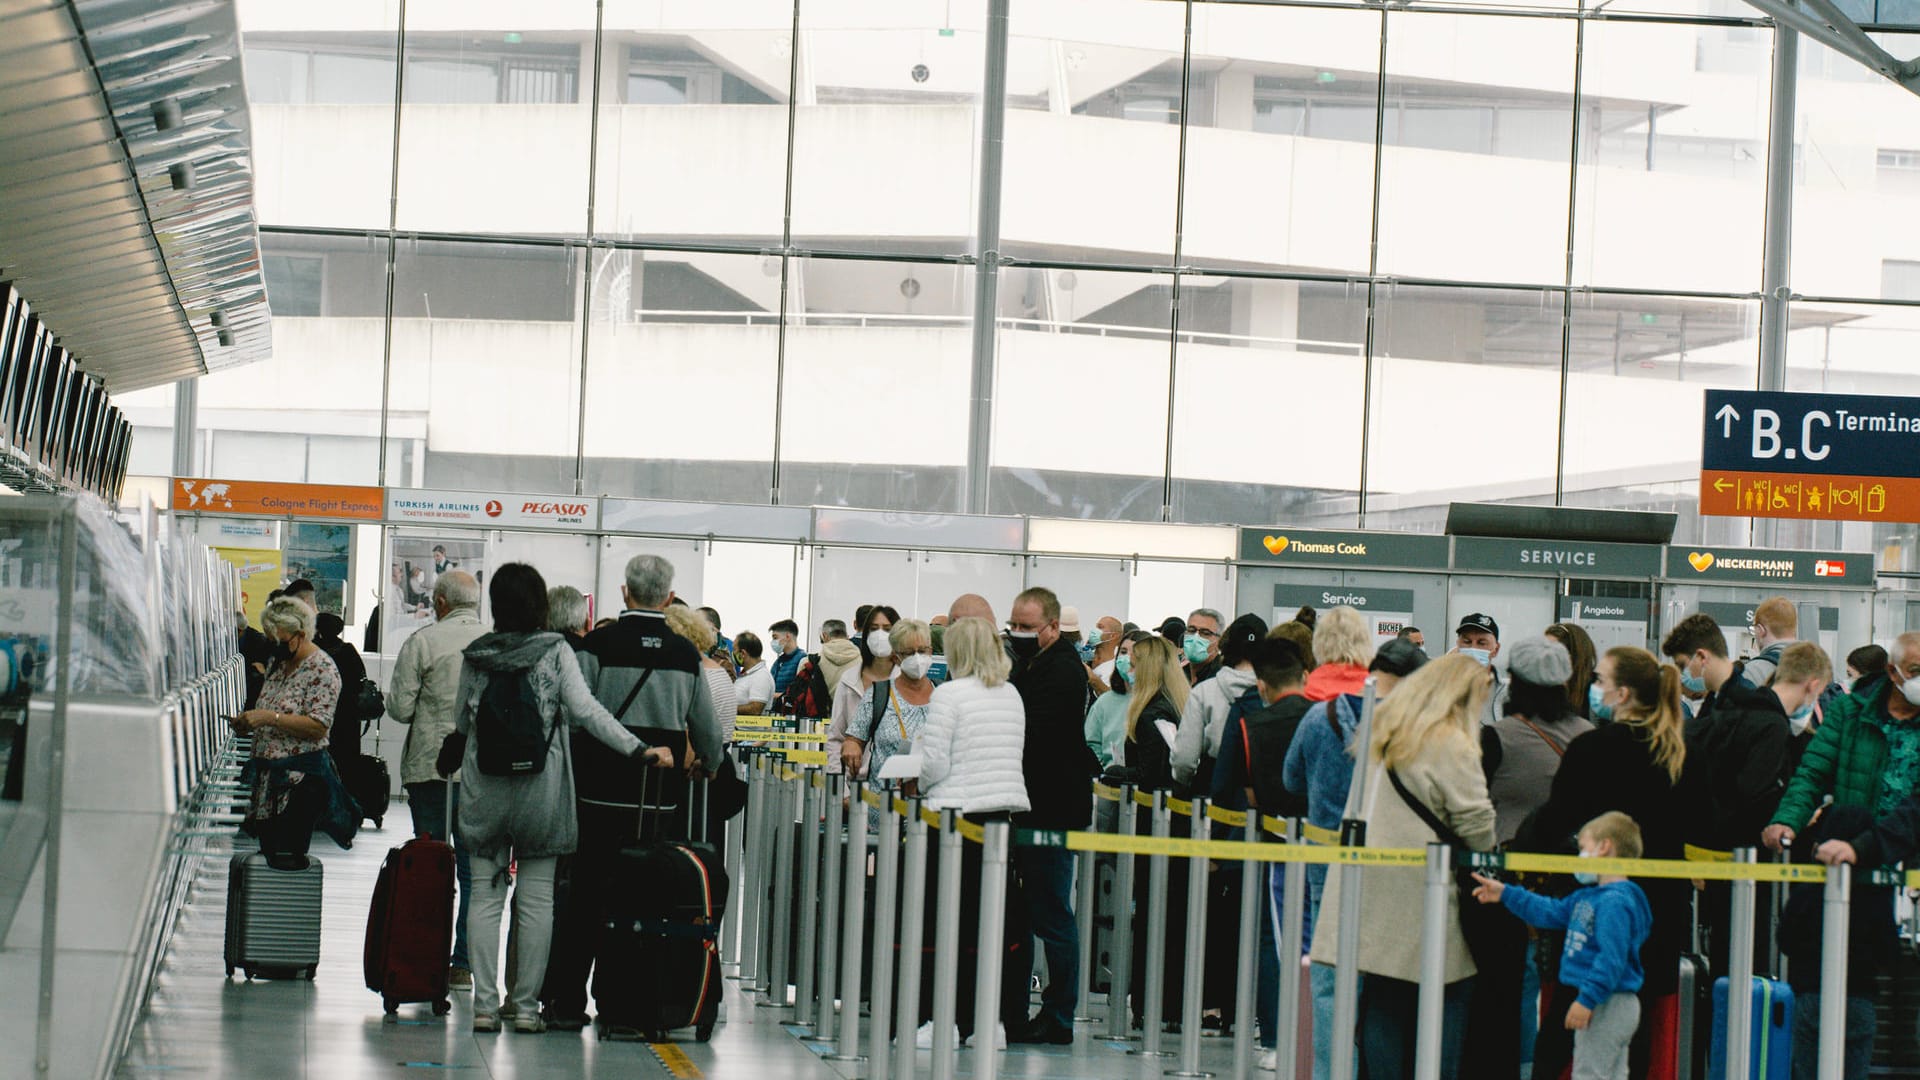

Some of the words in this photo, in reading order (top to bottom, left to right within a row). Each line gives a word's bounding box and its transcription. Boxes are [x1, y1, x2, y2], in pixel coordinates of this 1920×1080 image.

[1752, 408, 1831, 460] B.C
[1836, 410, 1920, 432] Termina
[1753, 480, 1768, 490] WC
[1783, 484, 1798, 495] WC
[261, 497, 305, 509] Cologne
[309, 499, 338, 510] Flight
[341, 501, 379, 512] Express
[394, 500, 434, 509] TURKISH
[438, 503, 480, 512] AIRLINES
[521, 502, 589, 516] PEGASUS
[1290, 540, 1335, 554] Thomas
[1336, 543, 1367, 556] Cook
[1521, 550, 1596, 565] SERVICE
[1716, 558, 1793, 570] NECKERMANN
[1322, 592, 1367, 606] Service
[1583, 606, 1625, 616] Angebote
